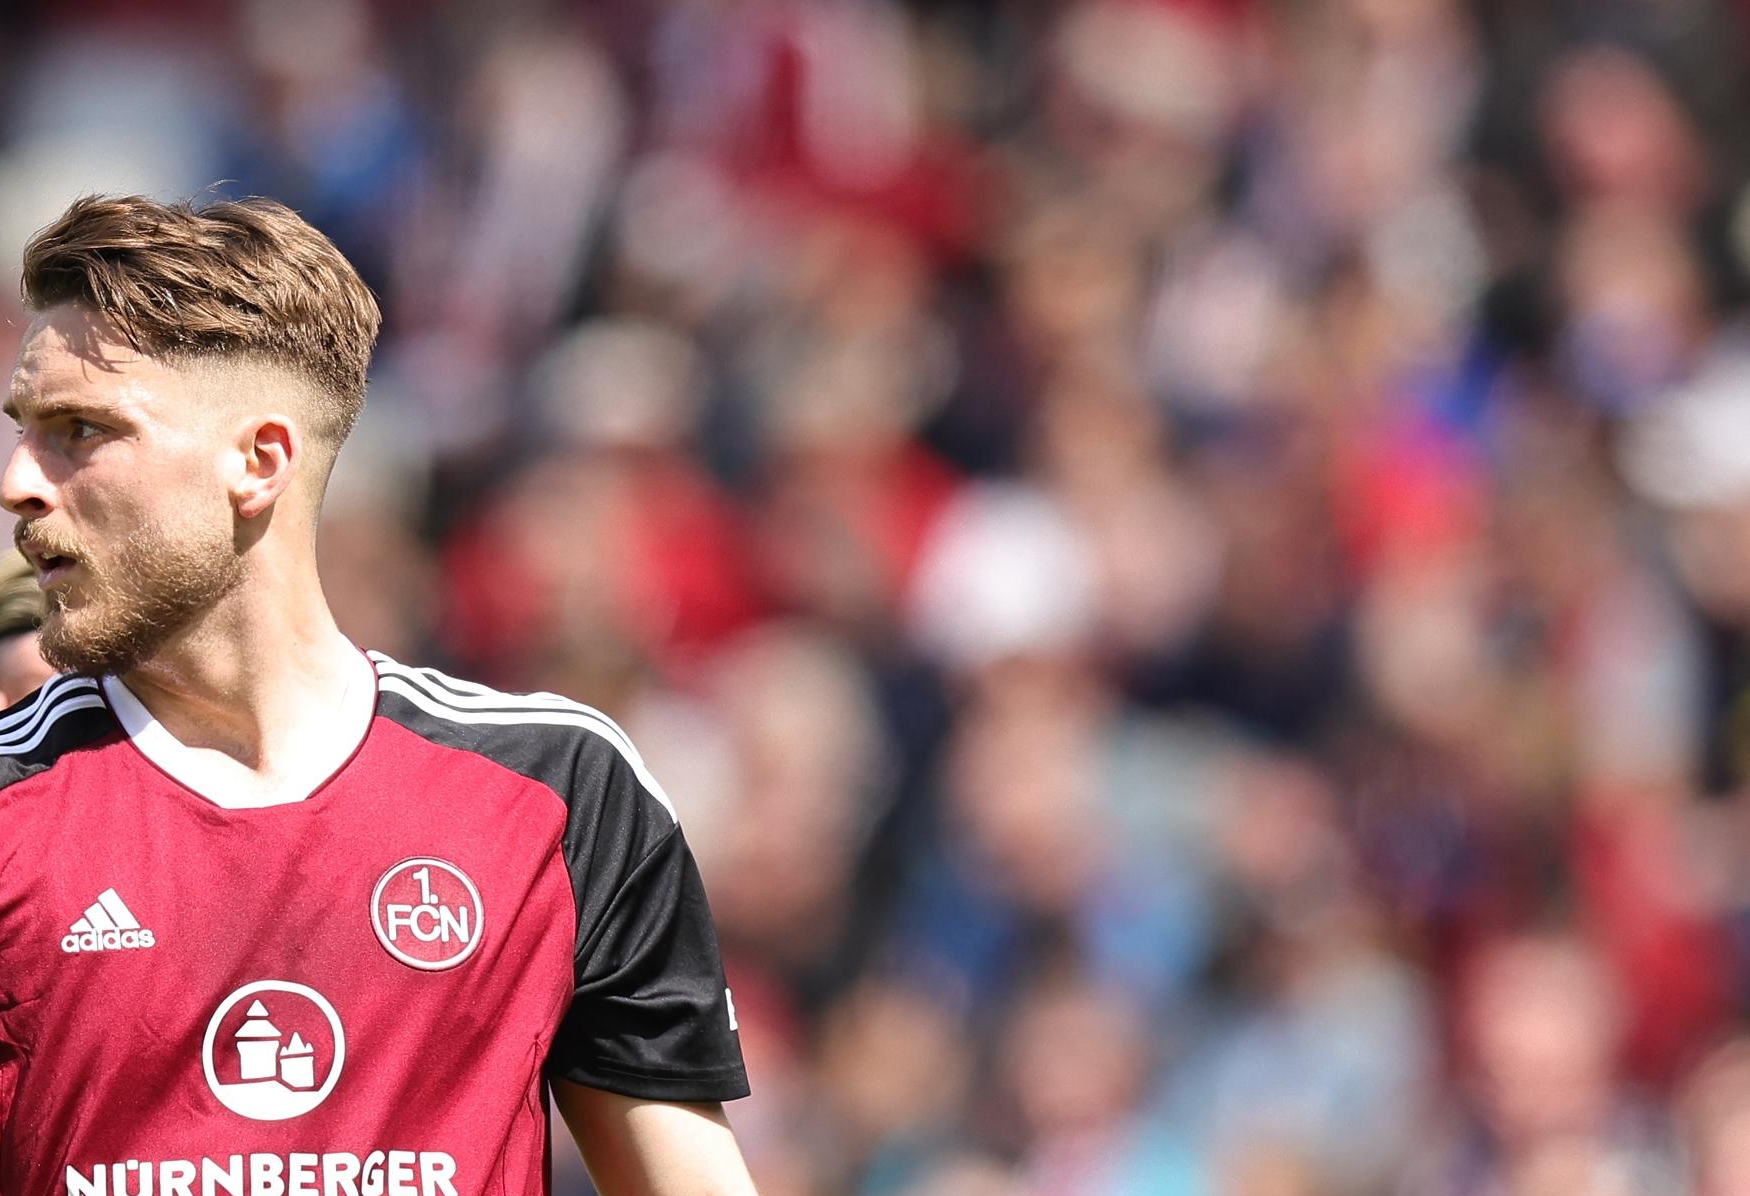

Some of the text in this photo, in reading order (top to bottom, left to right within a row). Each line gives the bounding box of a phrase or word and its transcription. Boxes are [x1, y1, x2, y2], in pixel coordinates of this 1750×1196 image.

[412, 867, 439, 904] 1.
[61, 926, 156, 953] adidas
[386, 904, 470, 943] FCN
